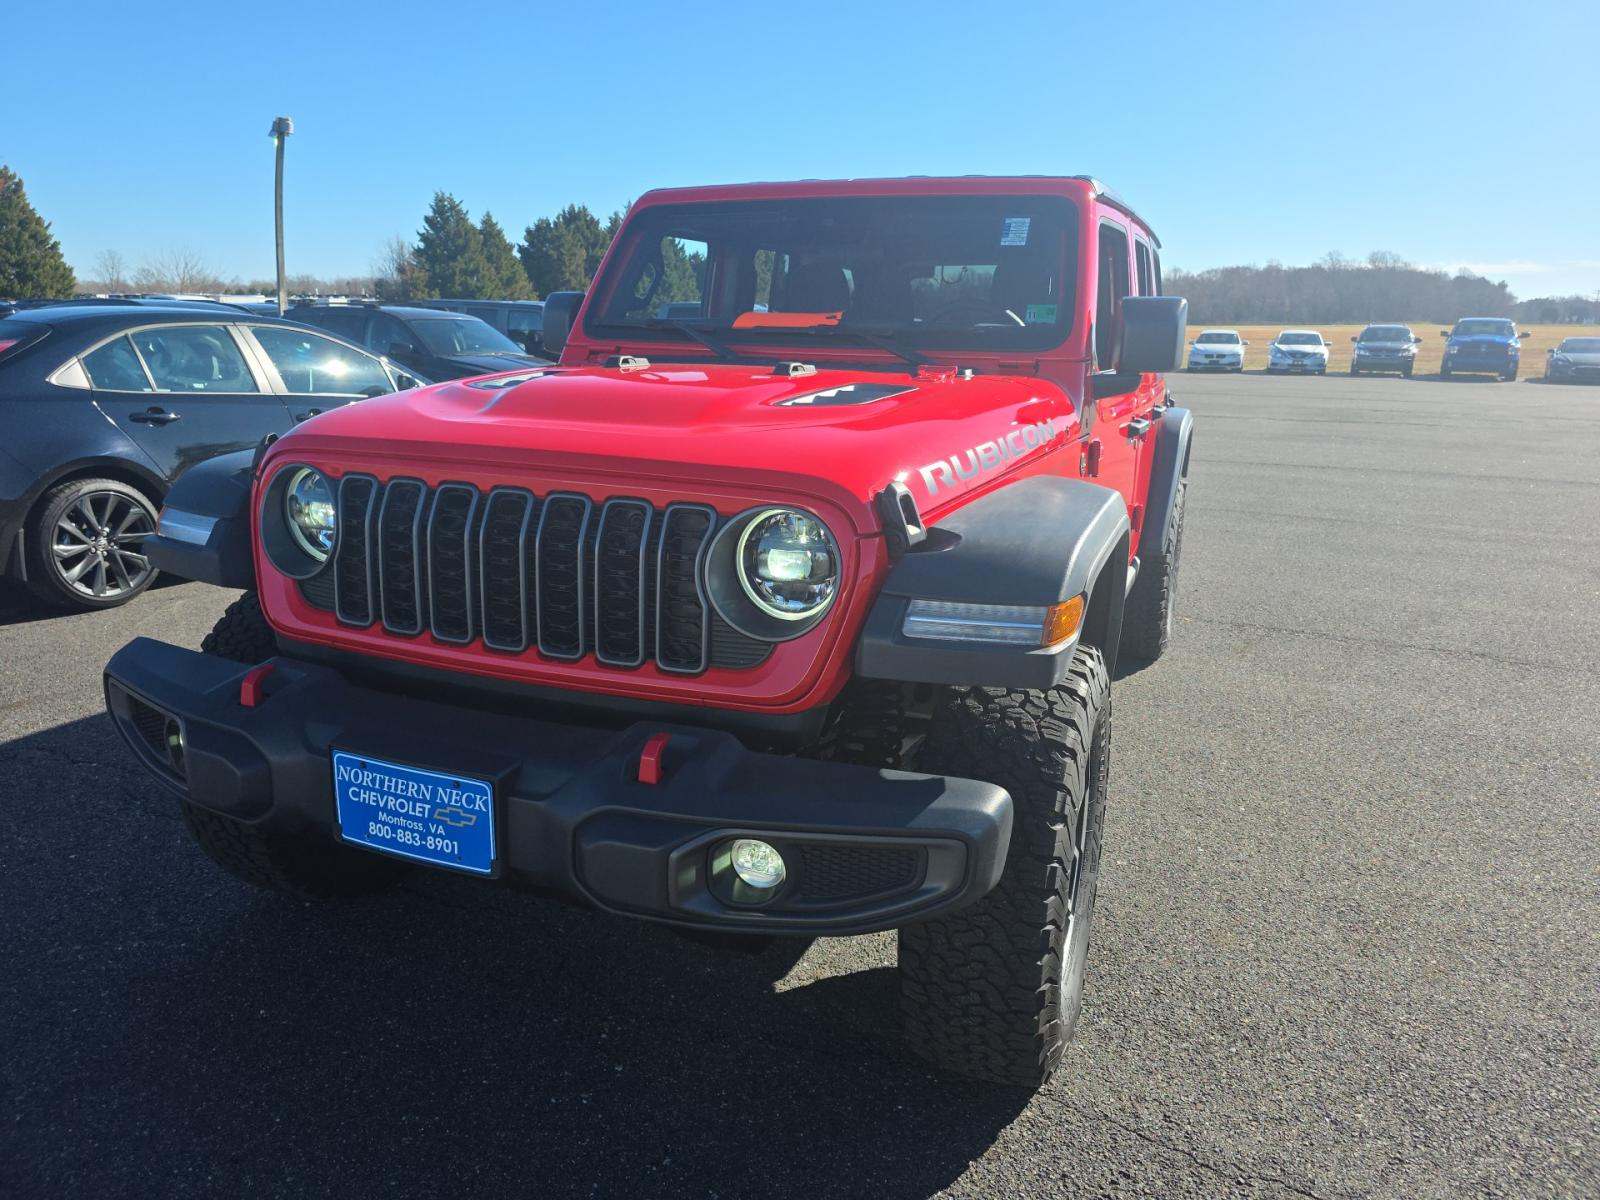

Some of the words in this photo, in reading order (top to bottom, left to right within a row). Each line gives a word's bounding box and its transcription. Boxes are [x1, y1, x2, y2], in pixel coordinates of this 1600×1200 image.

[919, 418, 1056, 496] RUBICON
[337, 765, 432, 800] NORTHERN
[436, 787, 488, 812] NECK
[348, 787, 431, 818] CHEVROLET
[368, 822, 459, 855] 800-883-8901
[378, 811, 426, 832] Montross,
[429, 823, 445, 836] VA
